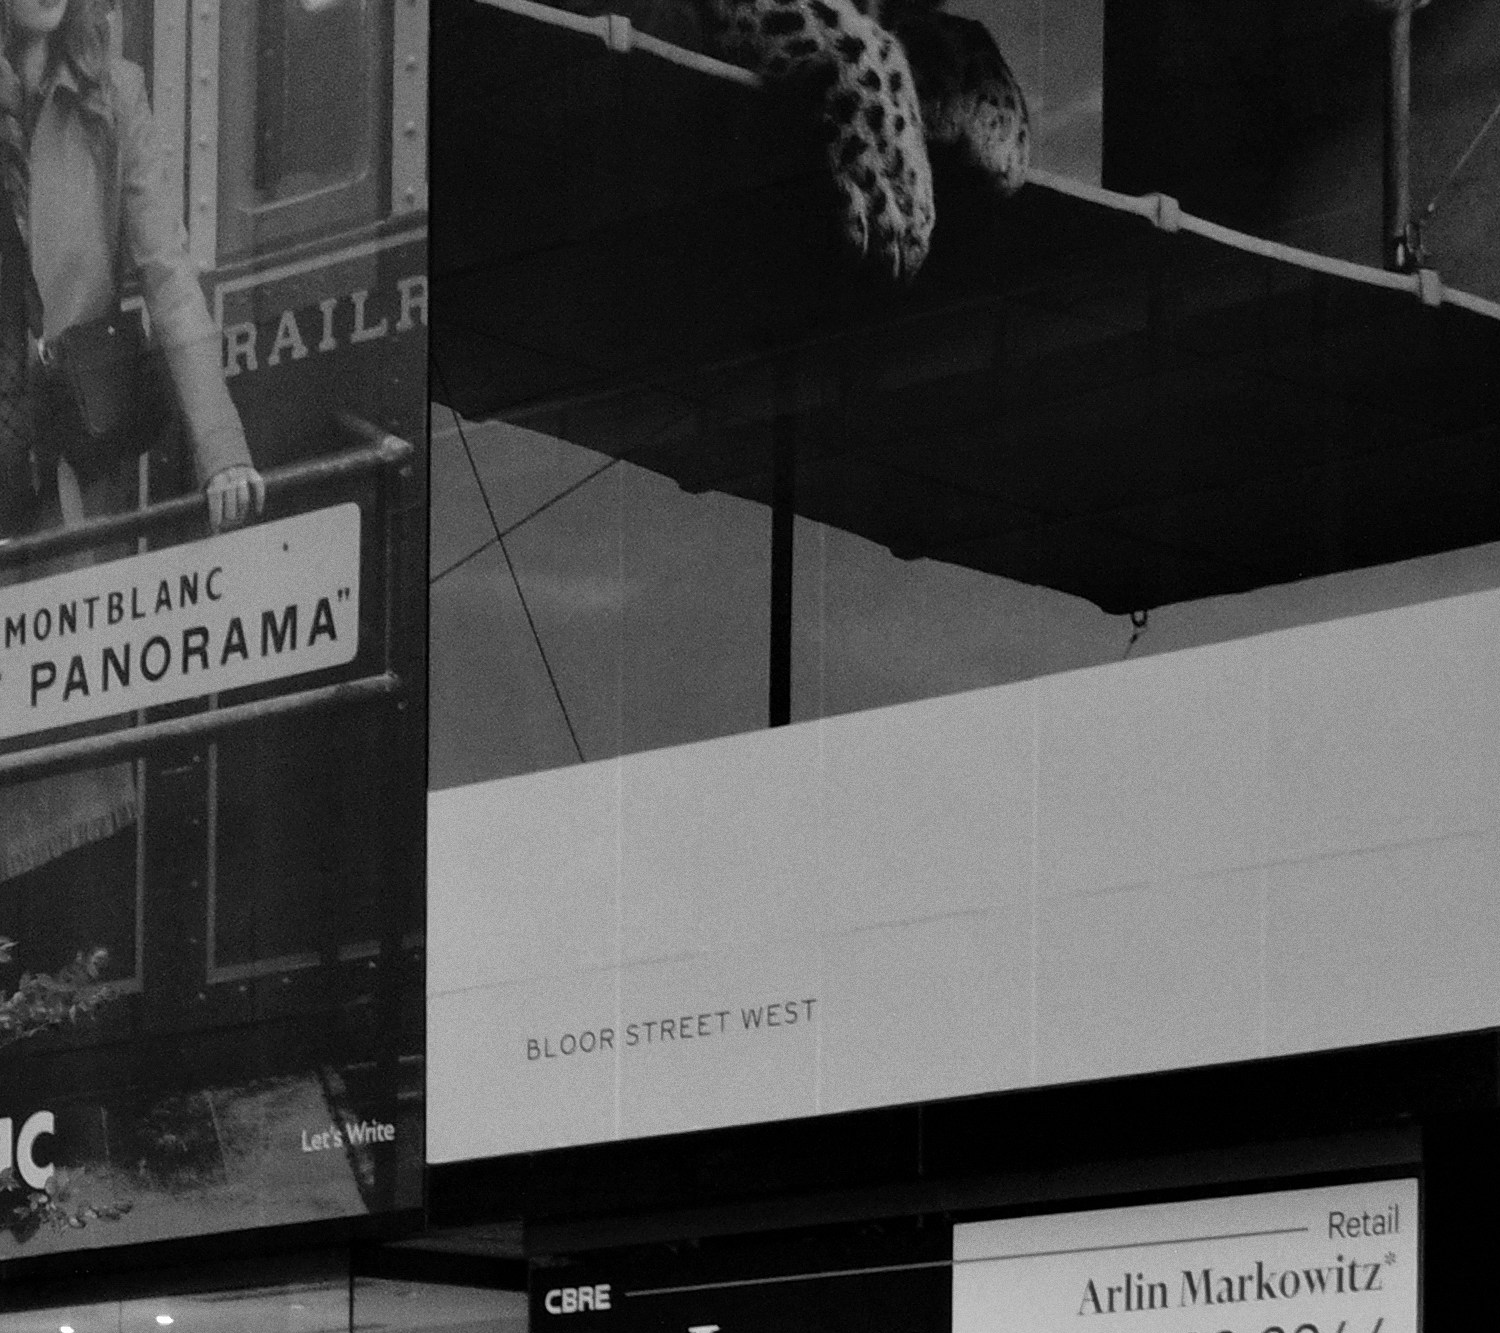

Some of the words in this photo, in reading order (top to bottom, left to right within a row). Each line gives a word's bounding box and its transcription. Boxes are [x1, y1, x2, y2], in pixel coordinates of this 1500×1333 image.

[4, 566, 223, 649] MONTBLANC
[30, 587, 351, 707] PANORAMA"
[527, 1028, 615, 1060] BLOOR
[625, 1011, 730, 1046] STREET
[741, 998, 817, 1029] WEST
[301, 1125, 343, 1152] Let's
[345, 1119, 395, 1145] Write
[1328, 1204, 1400, 1240] Retail
[544, 1284, 612, 1315] CBRE
[1077, 1272, 1168, 1316] Arlin
